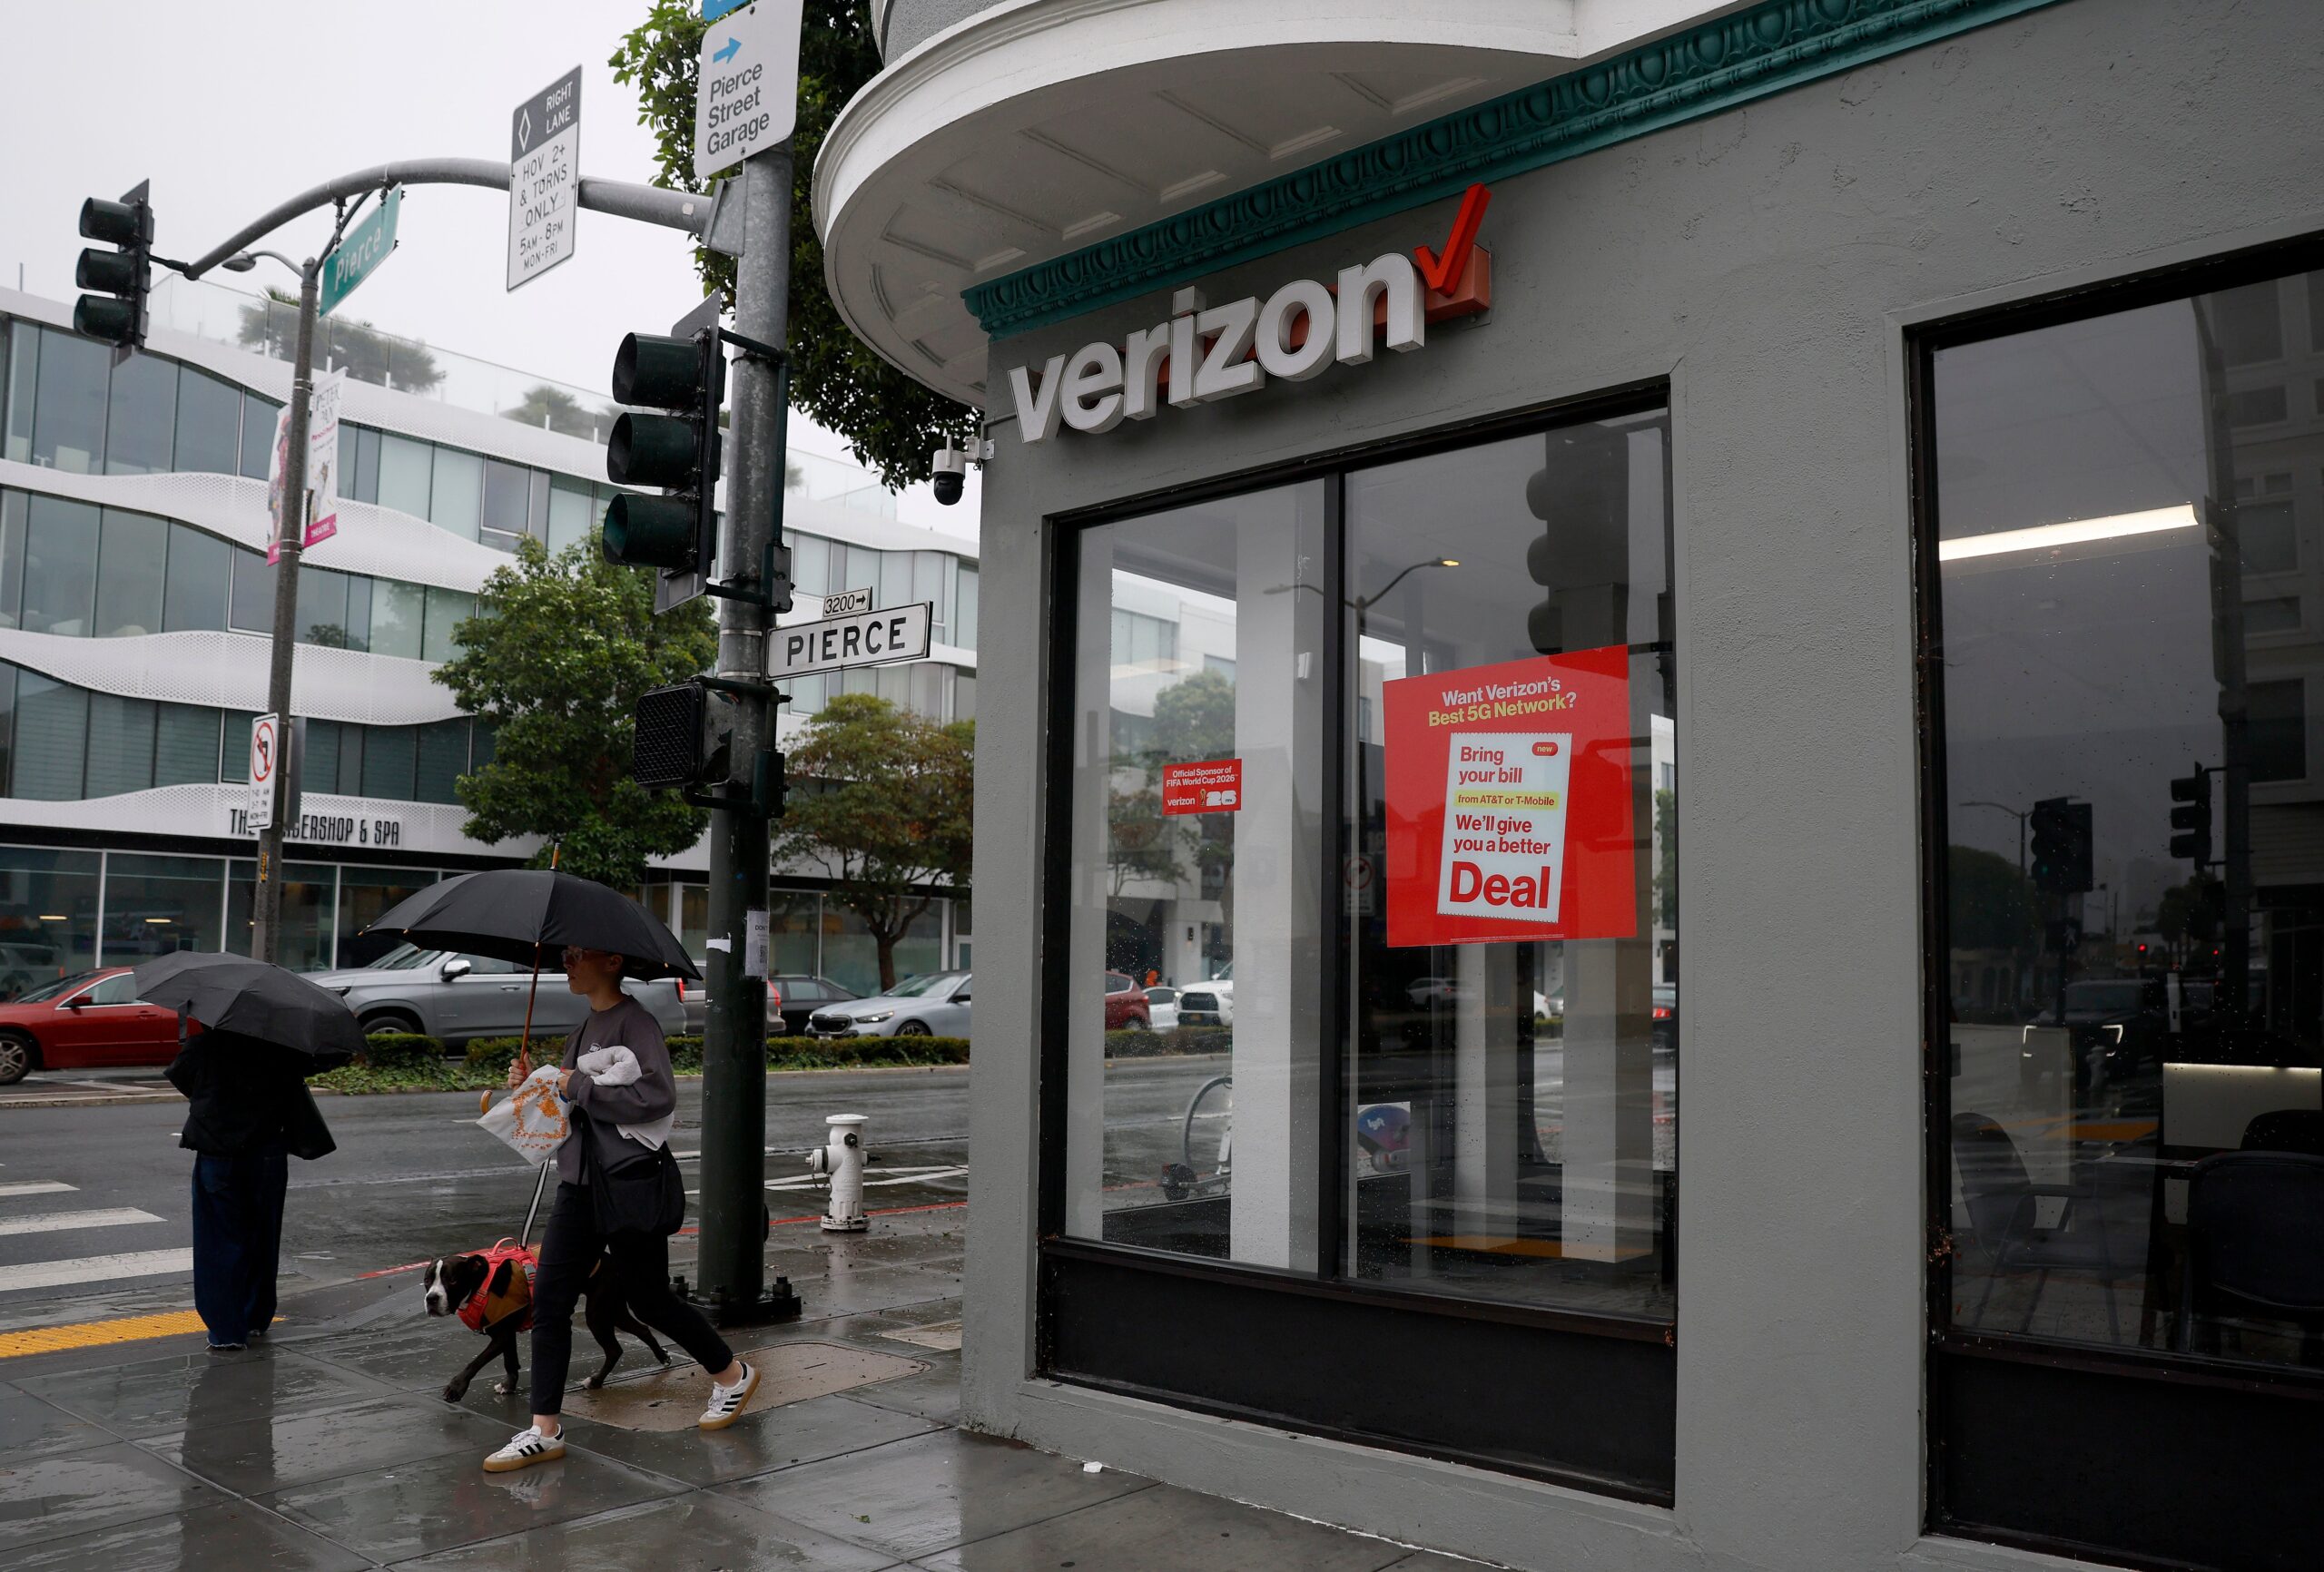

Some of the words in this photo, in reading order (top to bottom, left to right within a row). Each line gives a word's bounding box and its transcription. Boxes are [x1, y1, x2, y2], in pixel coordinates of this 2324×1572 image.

[546, 81, 573, 113] RIGHT
[710, 64, 763, 103] Pierce
[547, 104, 571, 134] LANE
[708, 86, 761, 129] Street
[707, 113, 770, 155] Garage
[523, 153, 545, 182] HOV
[552, 144, 565, 163] 2+
[520, 189, 527, 207] &
[533, 163, 567, 198] TURNS
[526, 192, 559, 227] ONLY
[334, 228, 381, 291] Pierce
[524, 241, 557, 270] MON-FRI
[1008, 252, 1423, 444] verizon
[824, 594, 855, 614] 3200
[787, 617, 907, 666] PIERCE
[1442, 687, 1483, 707] Want
[1485, 676, 1561, 701] Verizon's
[1428, 708, 1464, 726] Best
[1467, 703, 1492, 722] 5G
[1493, 692, 1577, 718] Network?
[1460, 746, 1504, 765] Bring
[1166, 779, 1181, 787] FIFA
[1182, 777, 1201, 786] World
[1202, 776, 1216, 785] Cup
[1172, 769, 1195, 778] Official
[1196, 767, 1224, 777] Sponsor
[1225, 765, 1232, 773] of
[1459, 771, 1495, 785] your
[1498, 767, 1523, 783] bill
[1167, 797, 1196, 806] verizon
[1206, 790, 1236, 806] 26
[1458, 794, 1479, 803] from
[1480, 795, 1503, 804] AT&T
[1515, 796, 1555, 806] T-Mobile
[231, 809, 255, 835] TH
[359, 819, 367, 843] &
[374, 820, 399, 845] SPA
[1455, 814, 1495, 831] We'll
[1497, 816, 1532, 835] give
[1453, 838, 1483, 853] you
[1486, 840, 1496, 852] a
[1499, 837, 1551, 854] better
[1449, 860, 1551, 909] Deal
